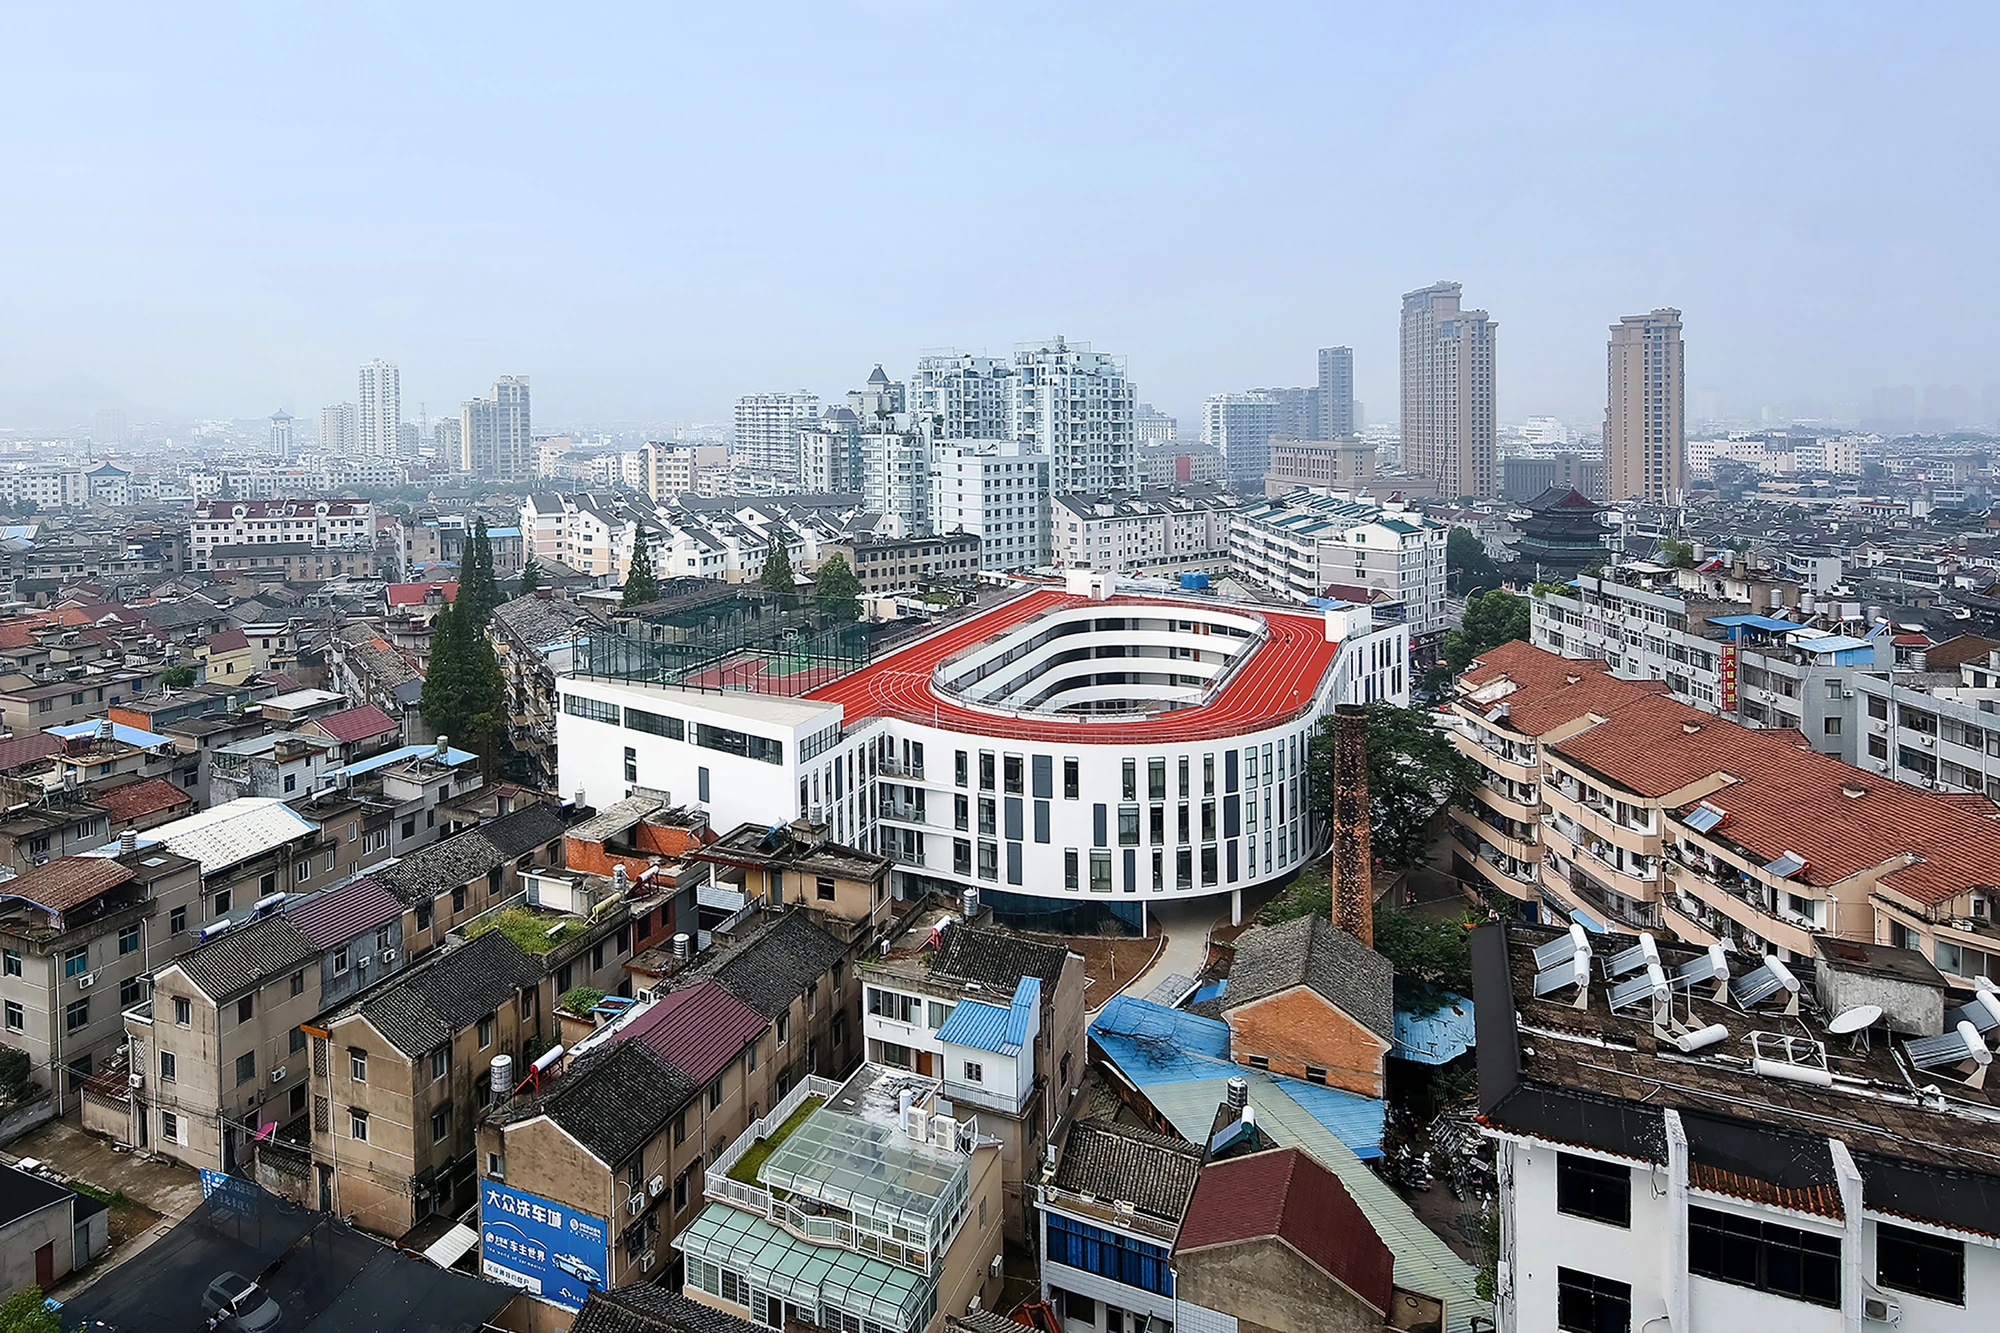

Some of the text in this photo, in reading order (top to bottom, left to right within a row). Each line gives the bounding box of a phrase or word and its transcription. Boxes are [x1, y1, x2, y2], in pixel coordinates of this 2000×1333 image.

[486, 1190, 562, 1230] 大众洗车城
[509, 1240, 546, 1262] 车主世界
